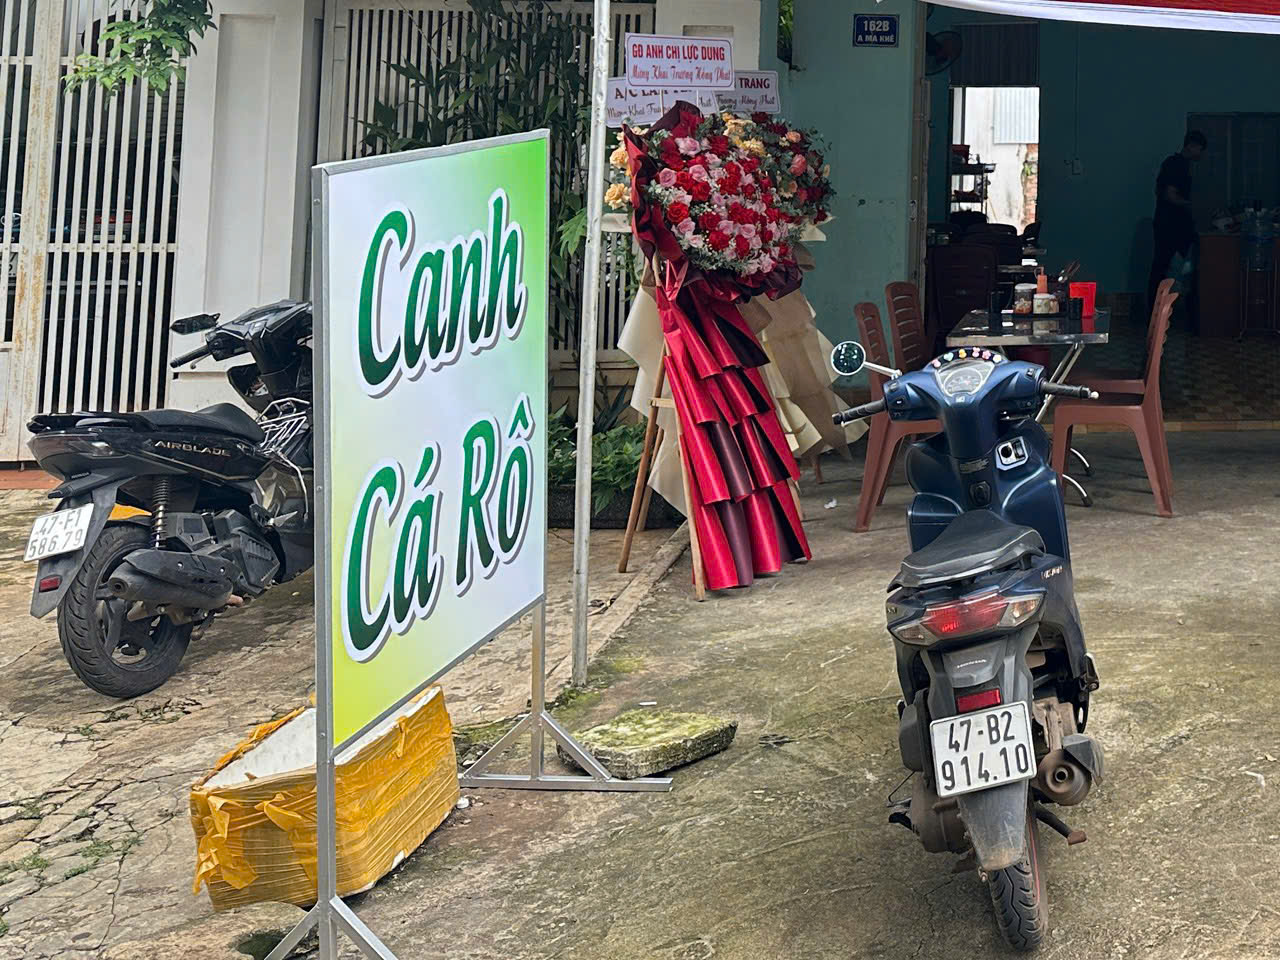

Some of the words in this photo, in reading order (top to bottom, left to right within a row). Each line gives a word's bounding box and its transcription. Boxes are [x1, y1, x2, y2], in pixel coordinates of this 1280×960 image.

[864, 20, 890, 31] 162B
[646, 45, 664, 59] ANH
[666, 45, 681, 63] CHỊ
[682, 44, 699, 63] LỰC
[702, 46, 725, 61] DUNG
[739, 77, 770, 89] TRANG
[355, 188, 528, 397] Canh
[29, 529, 83, 559] 586.79
[341, 442, 442, 662] Cá
[455, 392, 535, 598] Rô
[947, 710, 1016, 753] 47-B2
[941, 744, 1031, 797] 914.10
